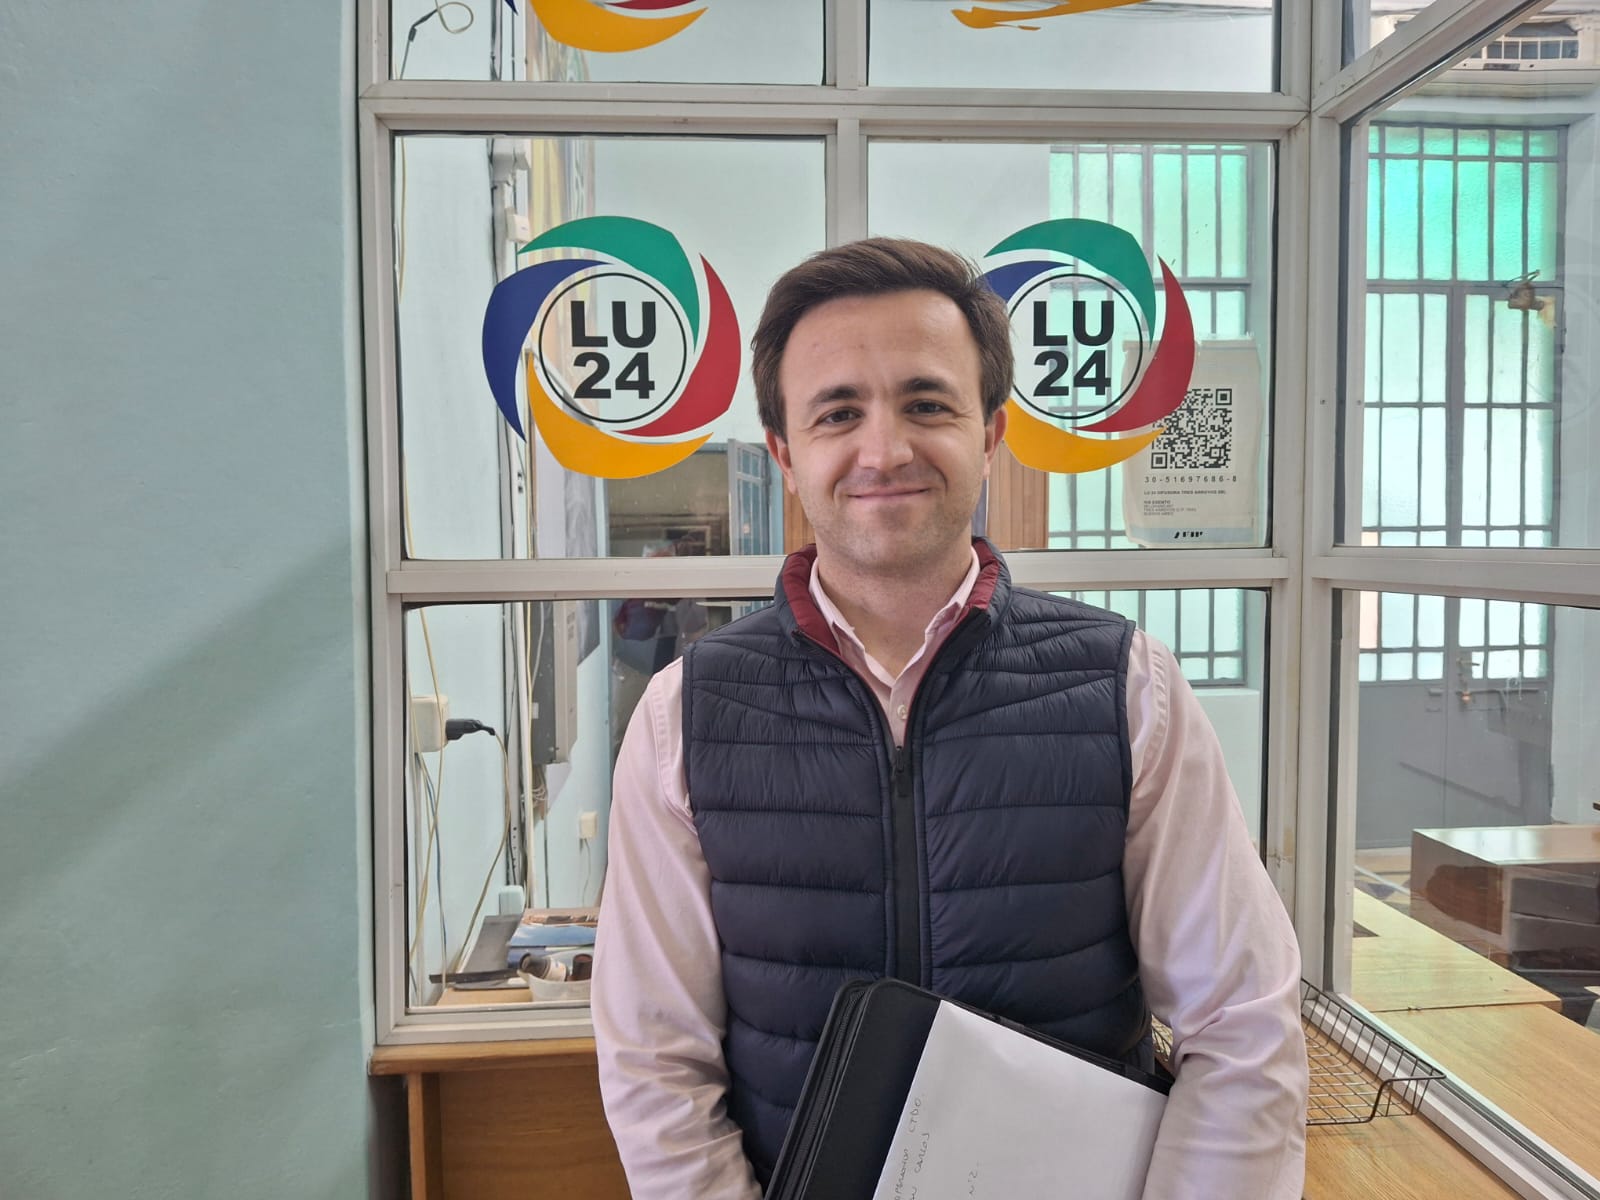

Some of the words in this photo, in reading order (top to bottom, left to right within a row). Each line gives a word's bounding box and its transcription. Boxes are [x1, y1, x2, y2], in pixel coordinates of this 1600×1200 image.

[570, 300, 657, 348] LU
[1033, 300, 1115, 347] LU
[573, 351, 656, 400] 24
[1033, 349, 1112, 397] 24
